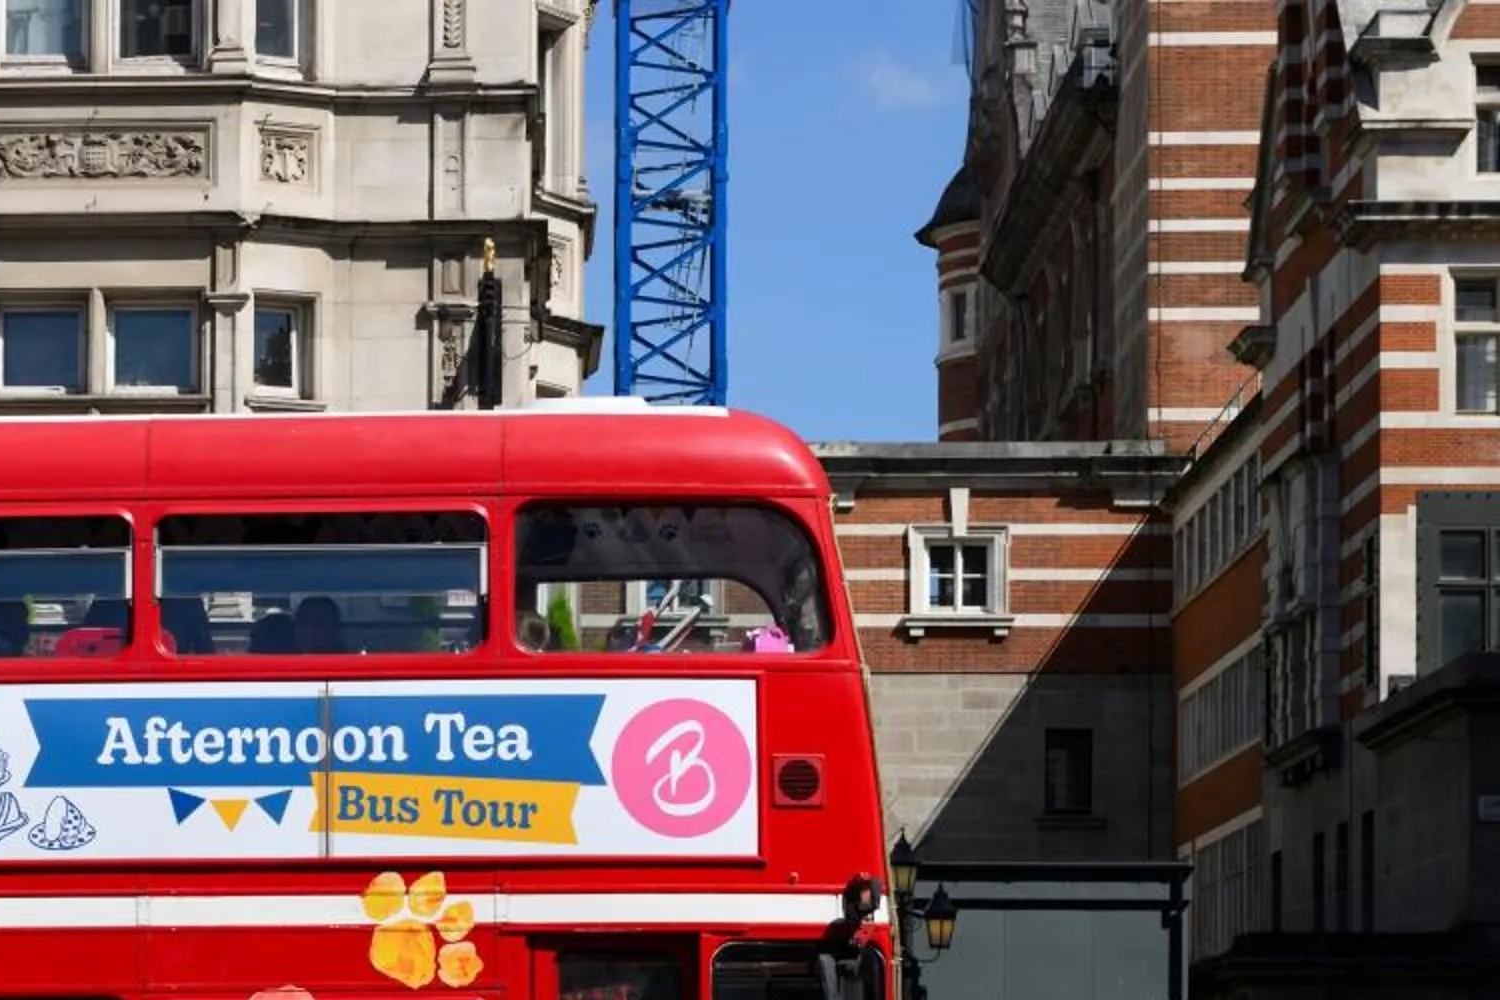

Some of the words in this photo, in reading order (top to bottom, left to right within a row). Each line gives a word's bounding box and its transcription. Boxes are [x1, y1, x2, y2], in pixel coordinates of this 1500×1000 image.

[97, 716, 408, 766] Afternoon
[424, 712, 533, 762] Tea
[336, 784, 420, 825] Bus
[433, 787, 538, 830] Tour
